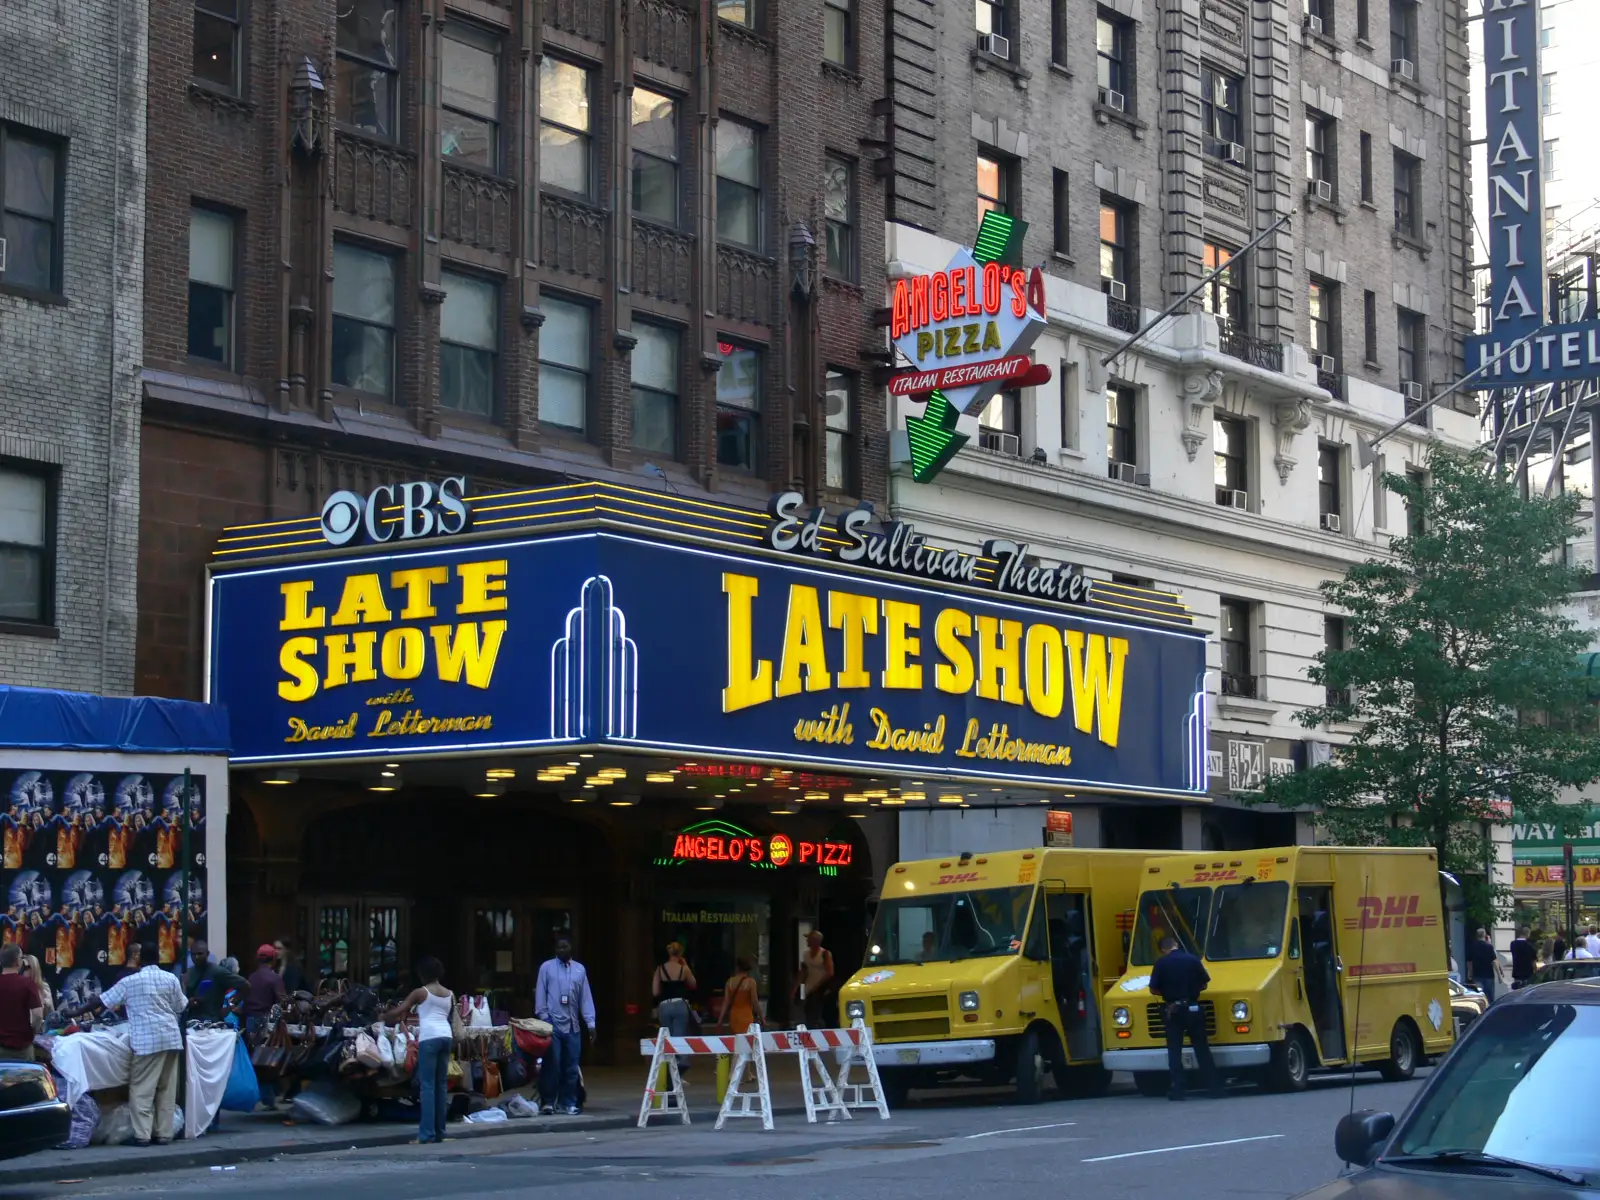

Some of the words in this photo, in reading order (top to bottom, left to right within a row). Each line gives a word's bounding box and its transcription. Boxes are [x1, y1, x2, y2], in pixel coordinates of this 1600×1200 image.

[1490, 0, 1536, 321] ITANIA
[892, 261, 1027, 338] ANGELO'S
[917, 321, 1001, 361] PIZZA
[1479, 329, 1600, 377] HOTEL
[893, 373, 938, 393] ITALIAN
[942, 358, 1022, 386] RESTAURANT
[365, 476, 468, 543] CBS
[771, 492, 825, 551] Ed
[839, 510, 978, 581] Sullivan
[991, 539, 1094, 602] Theater
[279, 559, 509, 631] LATE
[278, 618, 508, 702] SHOW
[721, 572, 923, 714] LATE
[934, 608, 1129, 748] SHOW
[366, 689, 414, 707] with
[285, 712, 359, 743] David
[368, 710, 493, 738] Letterman
[793, 703, 854, 746] with
[865, 707, 946, 754] David
[956, 718, 1072, 766] Letterman
[1230, 742, 1238, 788] BAR
[673, 835, 764, 861] ANGELO'S
[938, 872, 979, 885] DHL
[1193, 870, 1238, 882] DHL
[662, 909, 698, 923] ITALIAN
[700, 910, 759, 924] RESTAURANT
[1357, 896, 1425, 930] DHL
